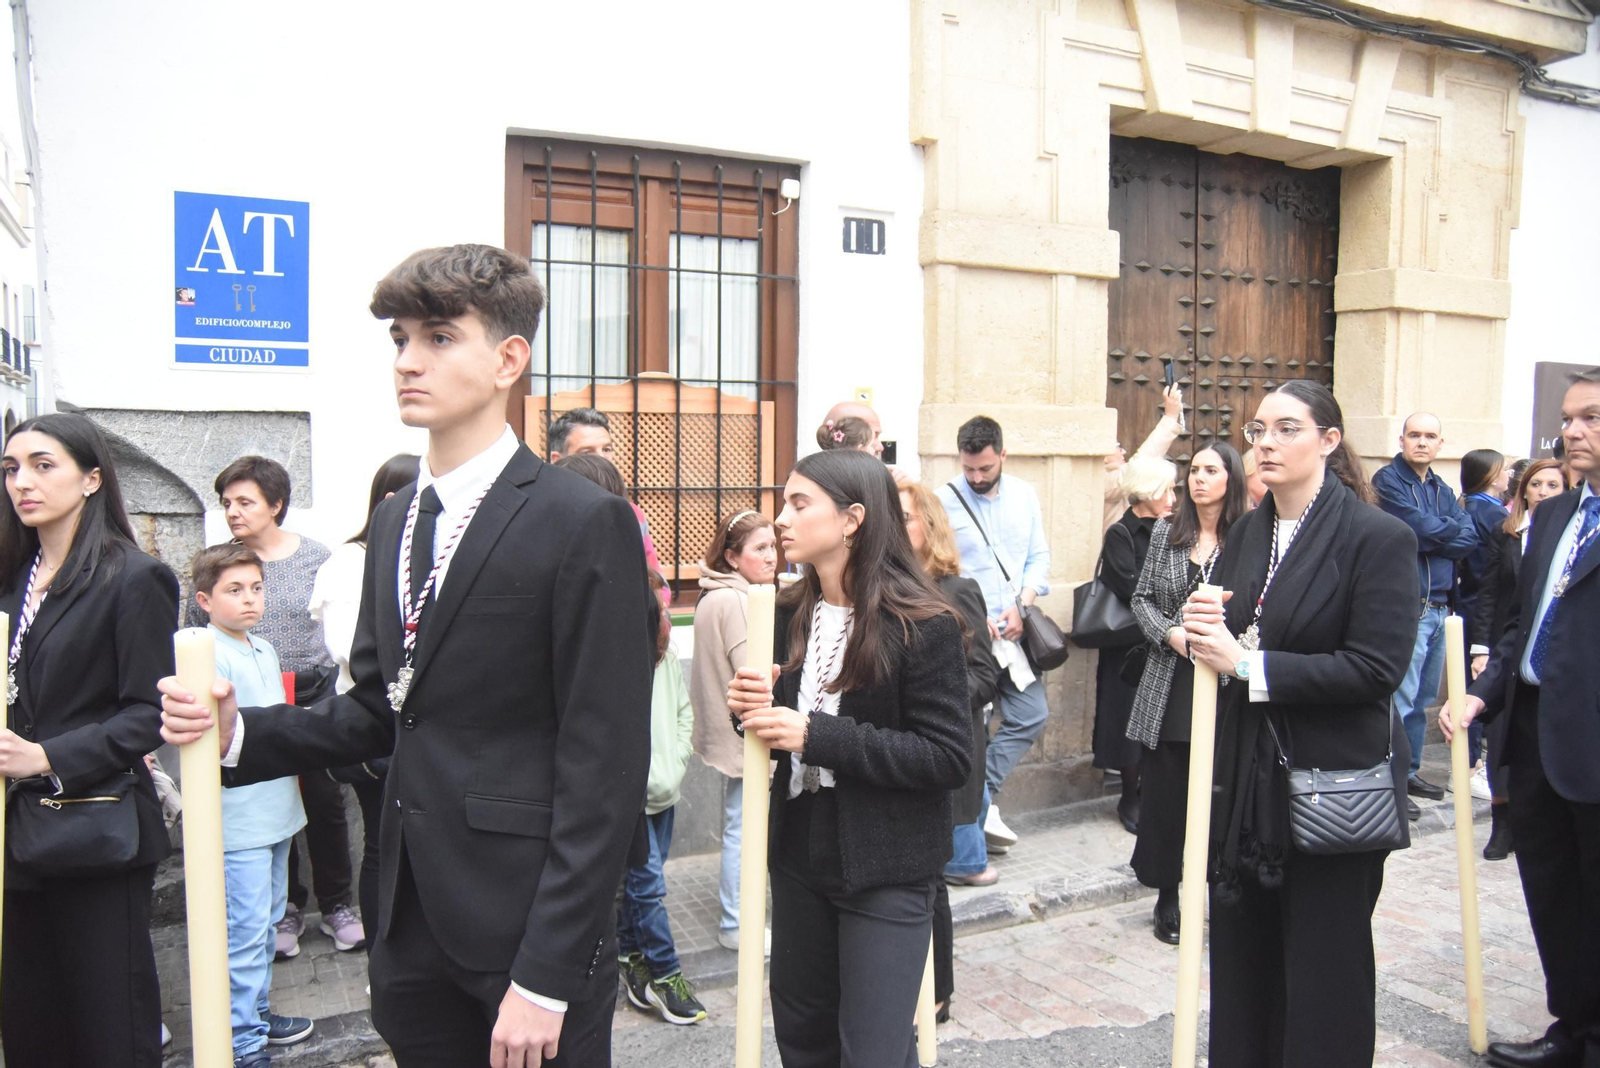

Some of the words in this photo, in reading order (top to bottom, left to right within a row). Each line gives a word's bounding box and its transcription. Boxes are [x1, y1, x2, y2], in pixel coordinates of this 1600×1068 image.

[186, 207, 295, 277] AT
[195, 317, 291, 330] EDIFICIO/COMPLEJO
[209, 347, 276, 364] CIUDAD
